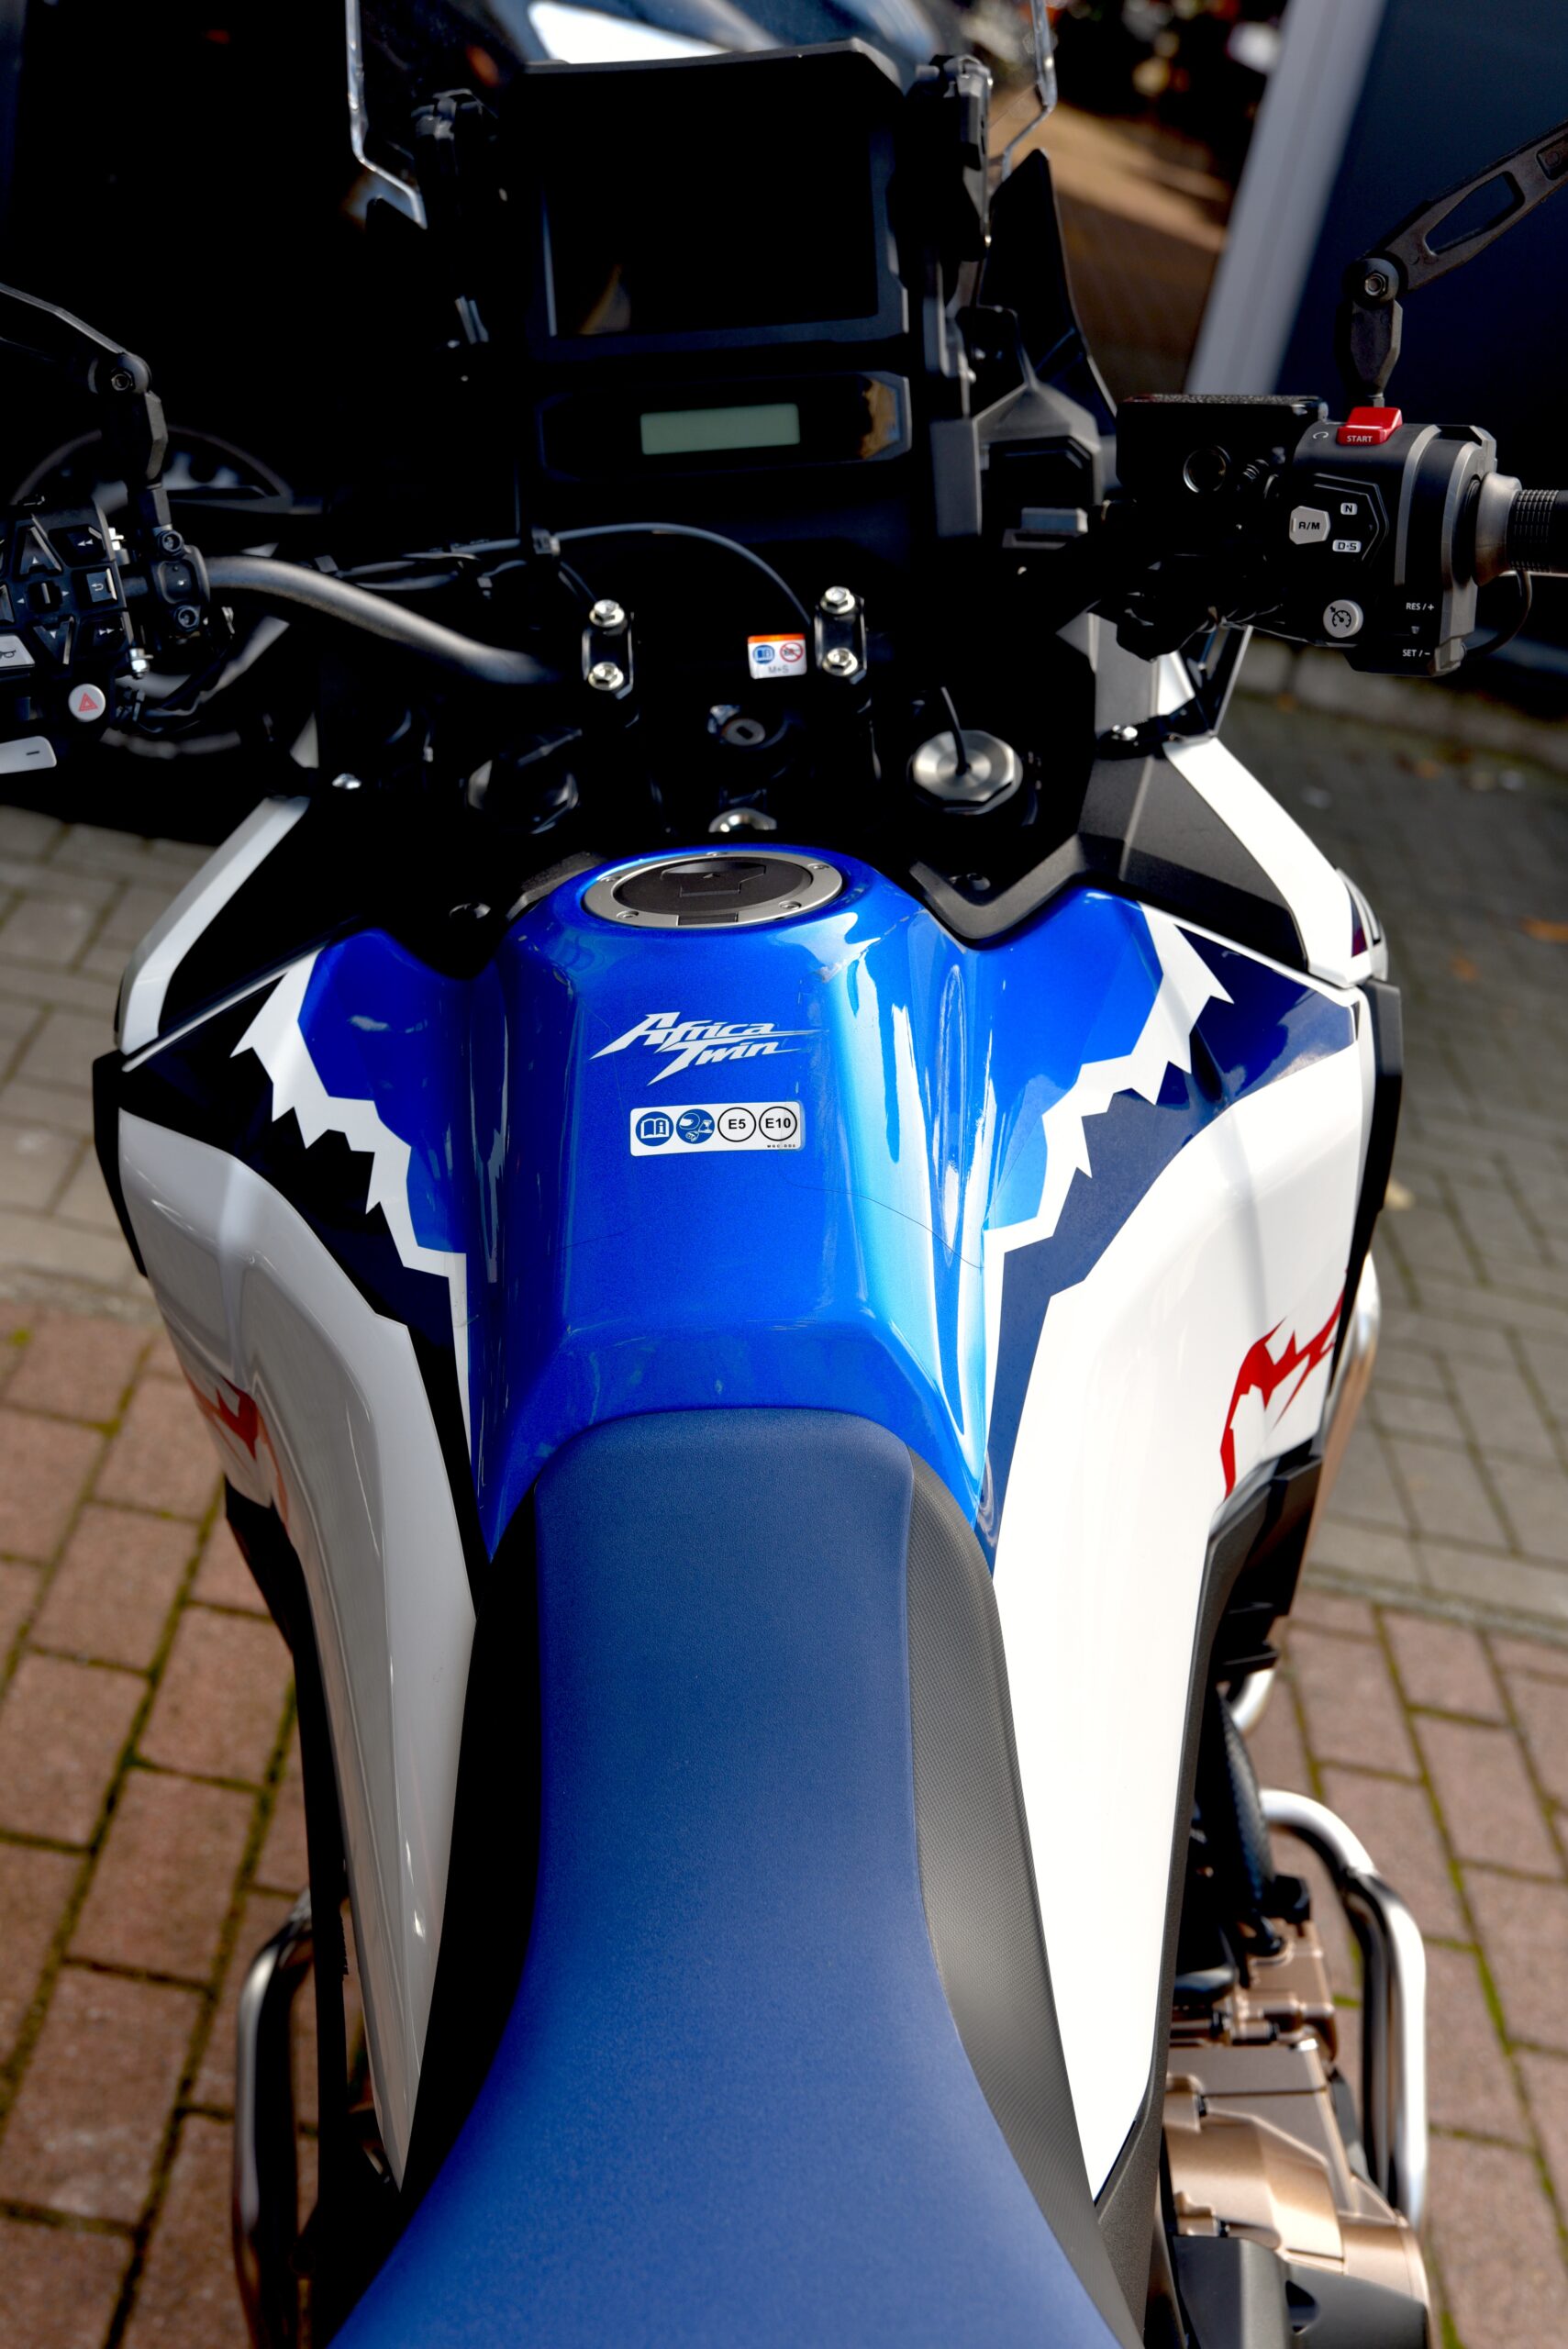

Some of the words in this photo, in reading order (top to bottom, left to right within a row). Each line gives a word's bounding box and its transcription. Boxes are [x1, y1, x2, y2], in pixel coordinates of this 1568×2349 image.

[1345, 505, 1353, 513] N
[588, 1012, 824, 1060] Africa
[647, 1037, 805, 1086] Twin
[728, 1119, 746, 1130] E5
[765, 1118, 792, 1129] E10
